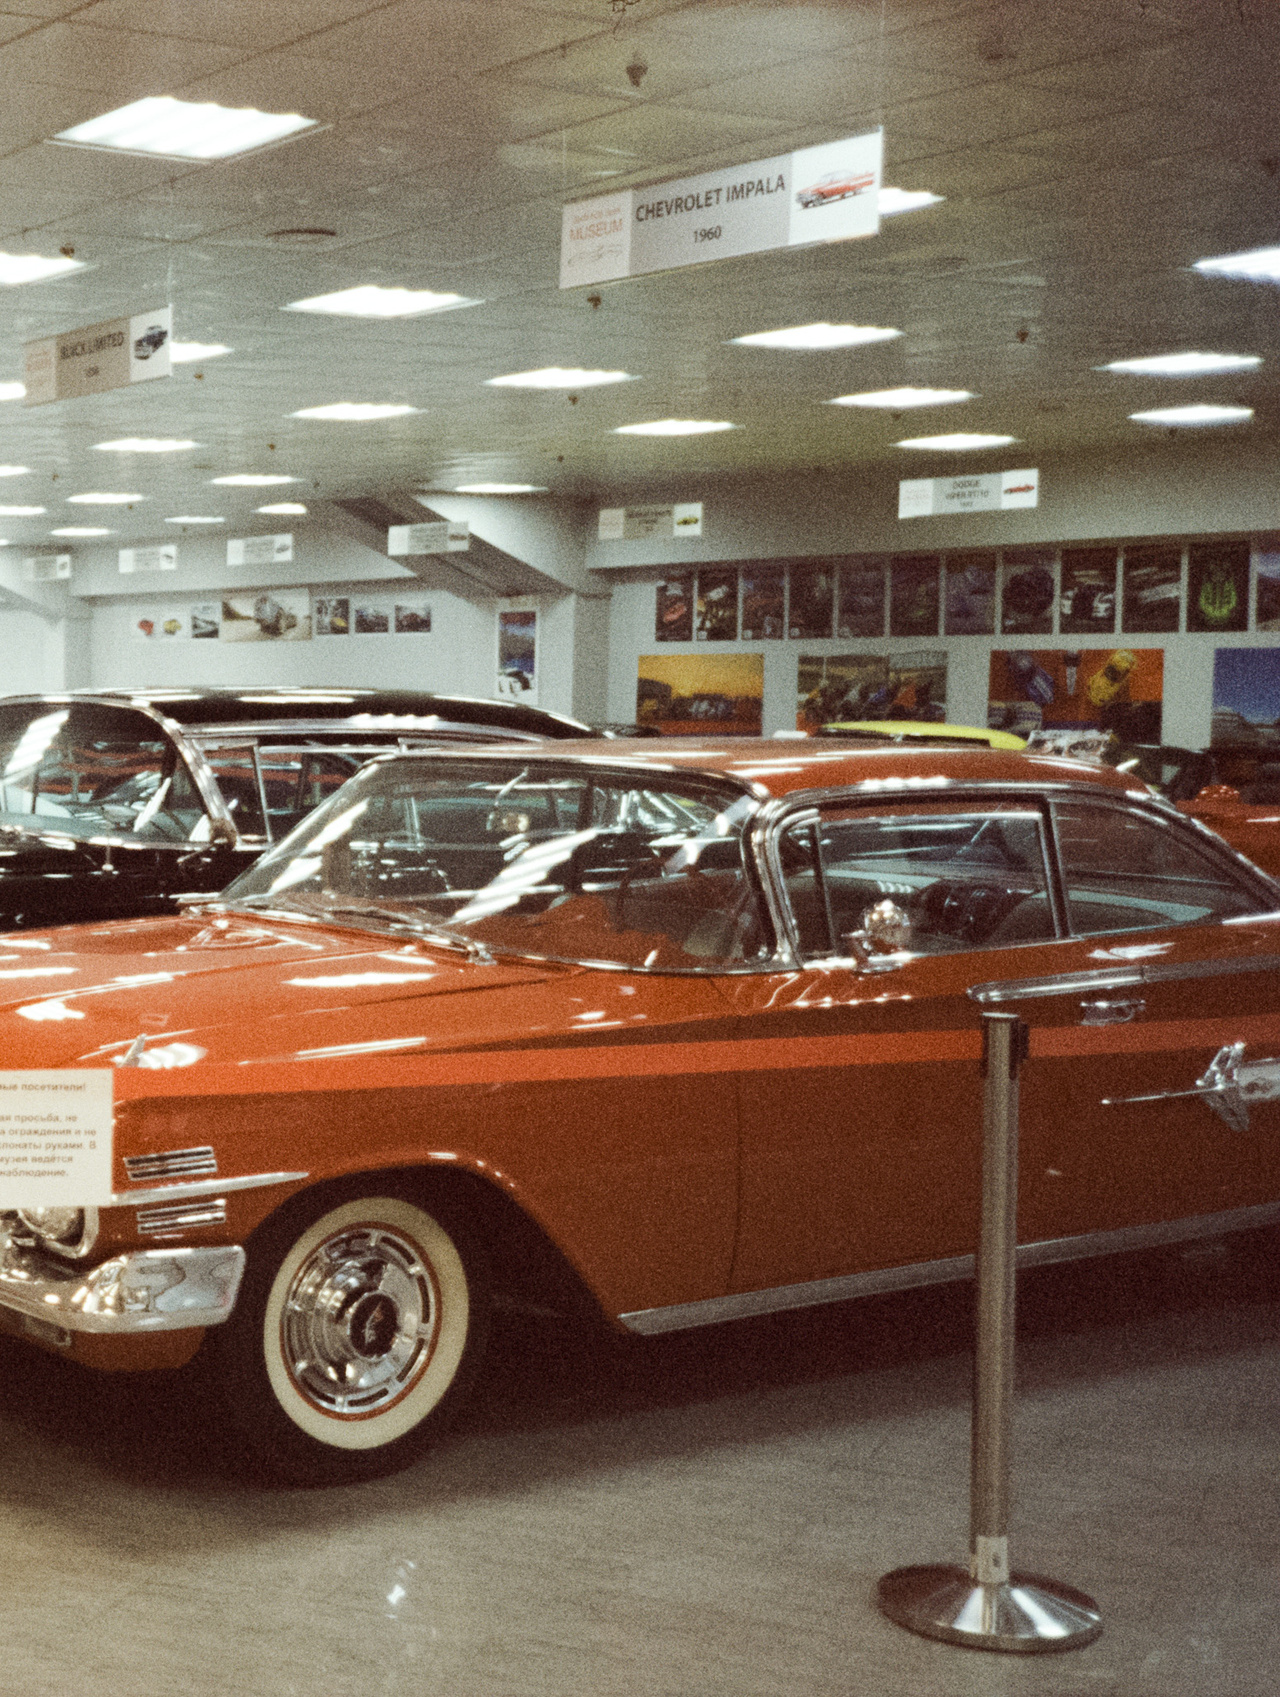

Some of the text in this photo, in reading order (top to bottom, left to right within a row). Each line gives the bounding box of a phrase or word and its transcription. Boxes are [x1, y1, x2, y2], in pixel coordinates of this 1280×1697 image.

[635, 188, 722, 222] CHEVROLET
[726, 174, 786, 203] IMPALA
[693, 225, 722, 243] 1960
[21, 1082, 86, 1092] посетители!
[14, 1113, 62, 1124] просьба,
[8, 1128, 72, 1137] ограждения
[84, 1128, 97, 1136] не
[89, 1141, 97, 1149] В
